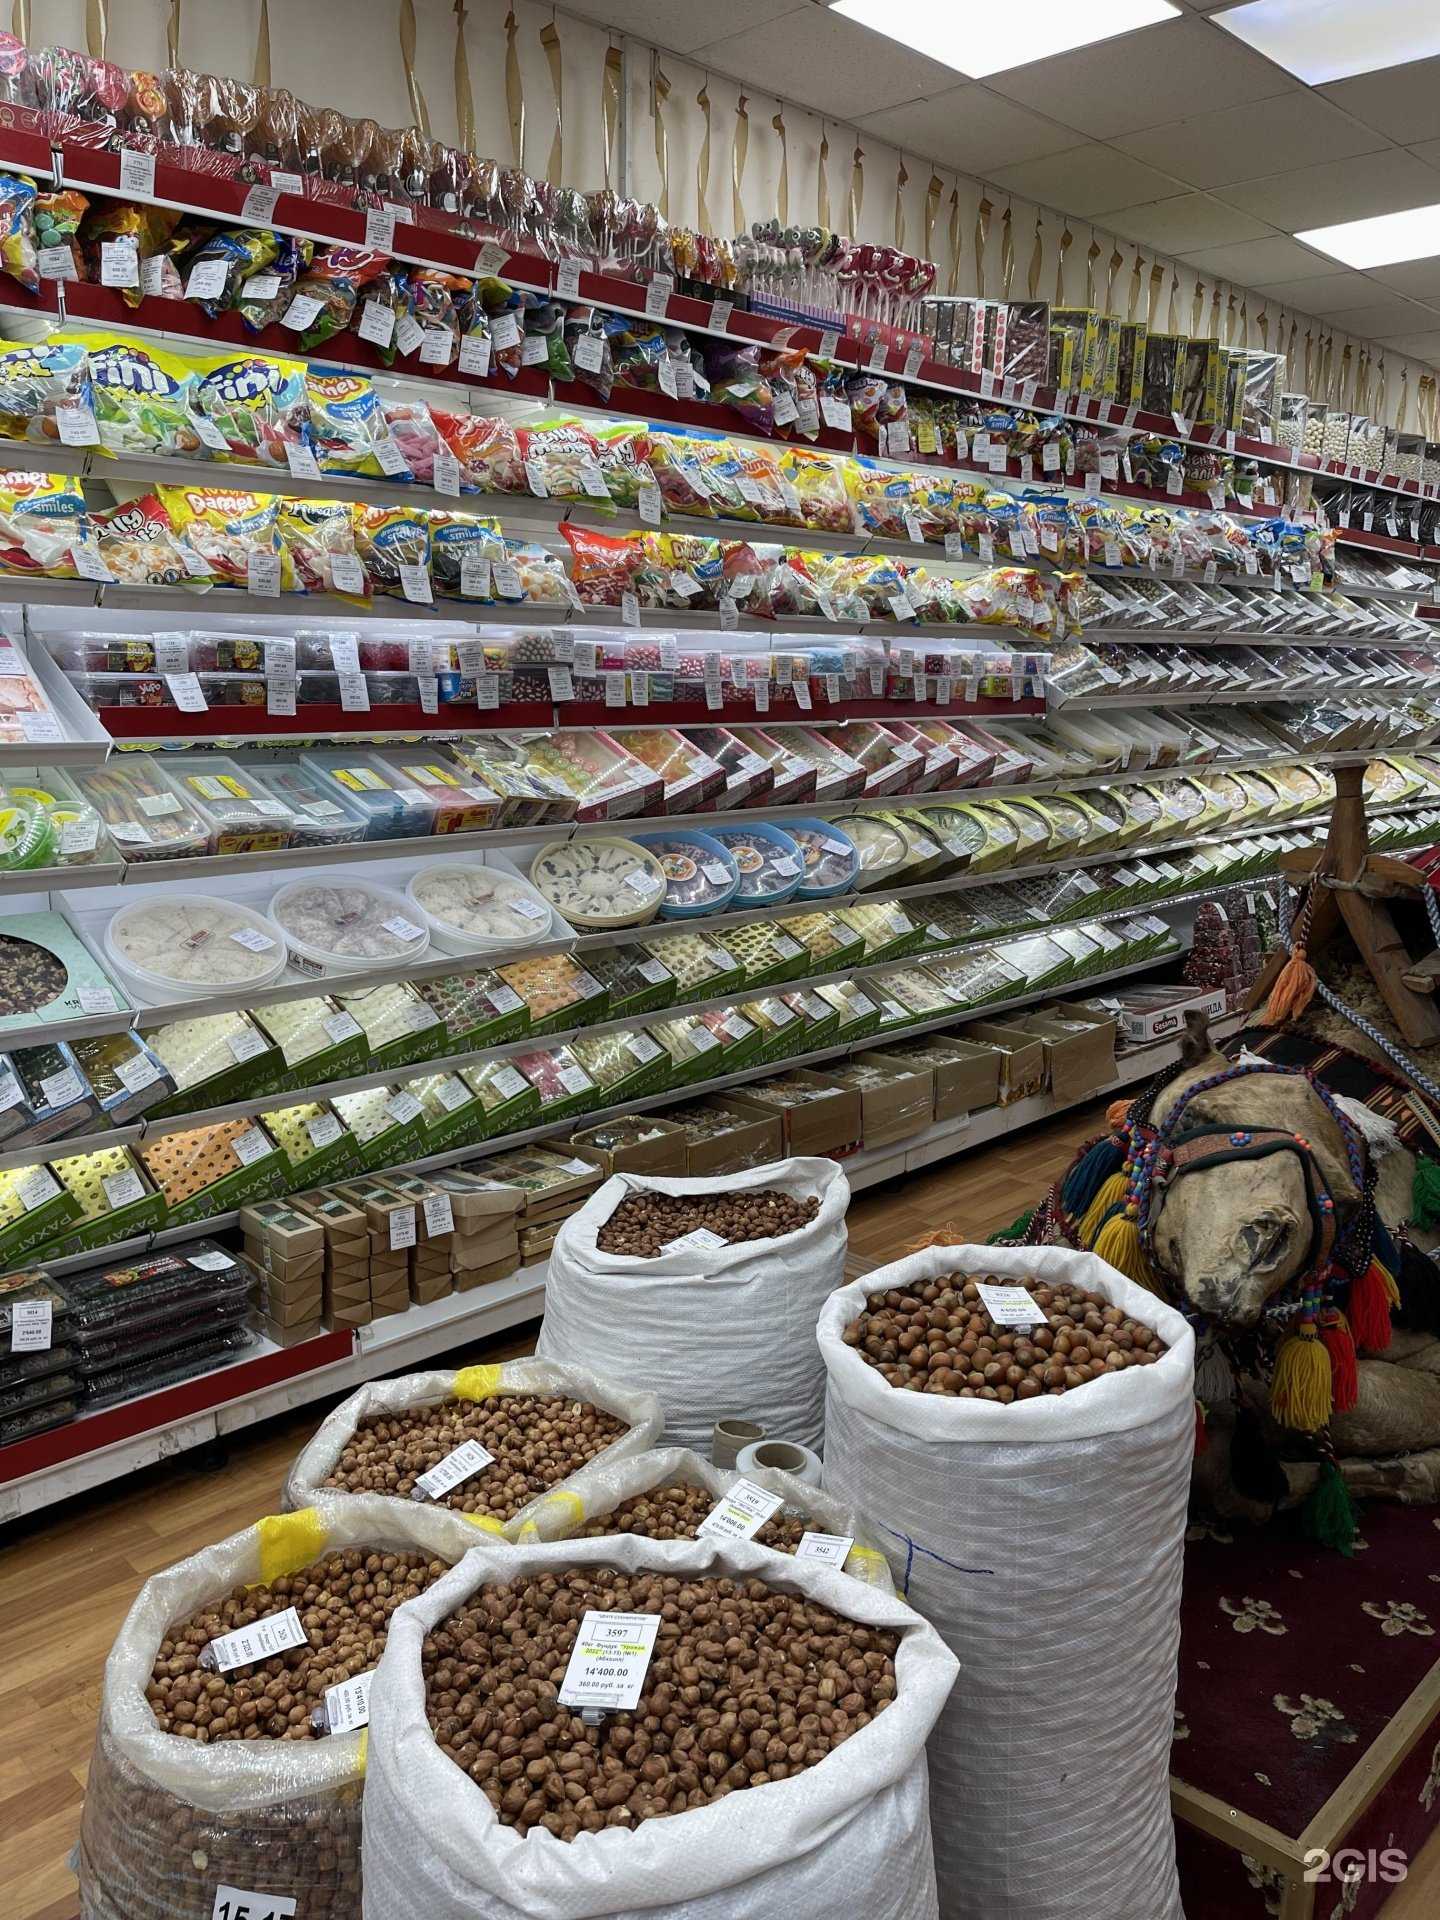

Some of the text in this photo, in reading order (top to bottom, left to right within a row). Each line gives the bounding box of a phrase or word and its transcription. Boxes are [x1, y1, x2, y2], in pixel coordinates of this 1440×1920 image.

[89, 349, 170, 395] Fini
[210, 363, 281, 401] Fini
[306, 377, 360, 398] amel
[0, 470, 51, 489] amel
[35, 500, 75, 513] smiles
[605, 1627, 629, 1638] 3597
[585, 1667, 629, 1677] 14'400.00
